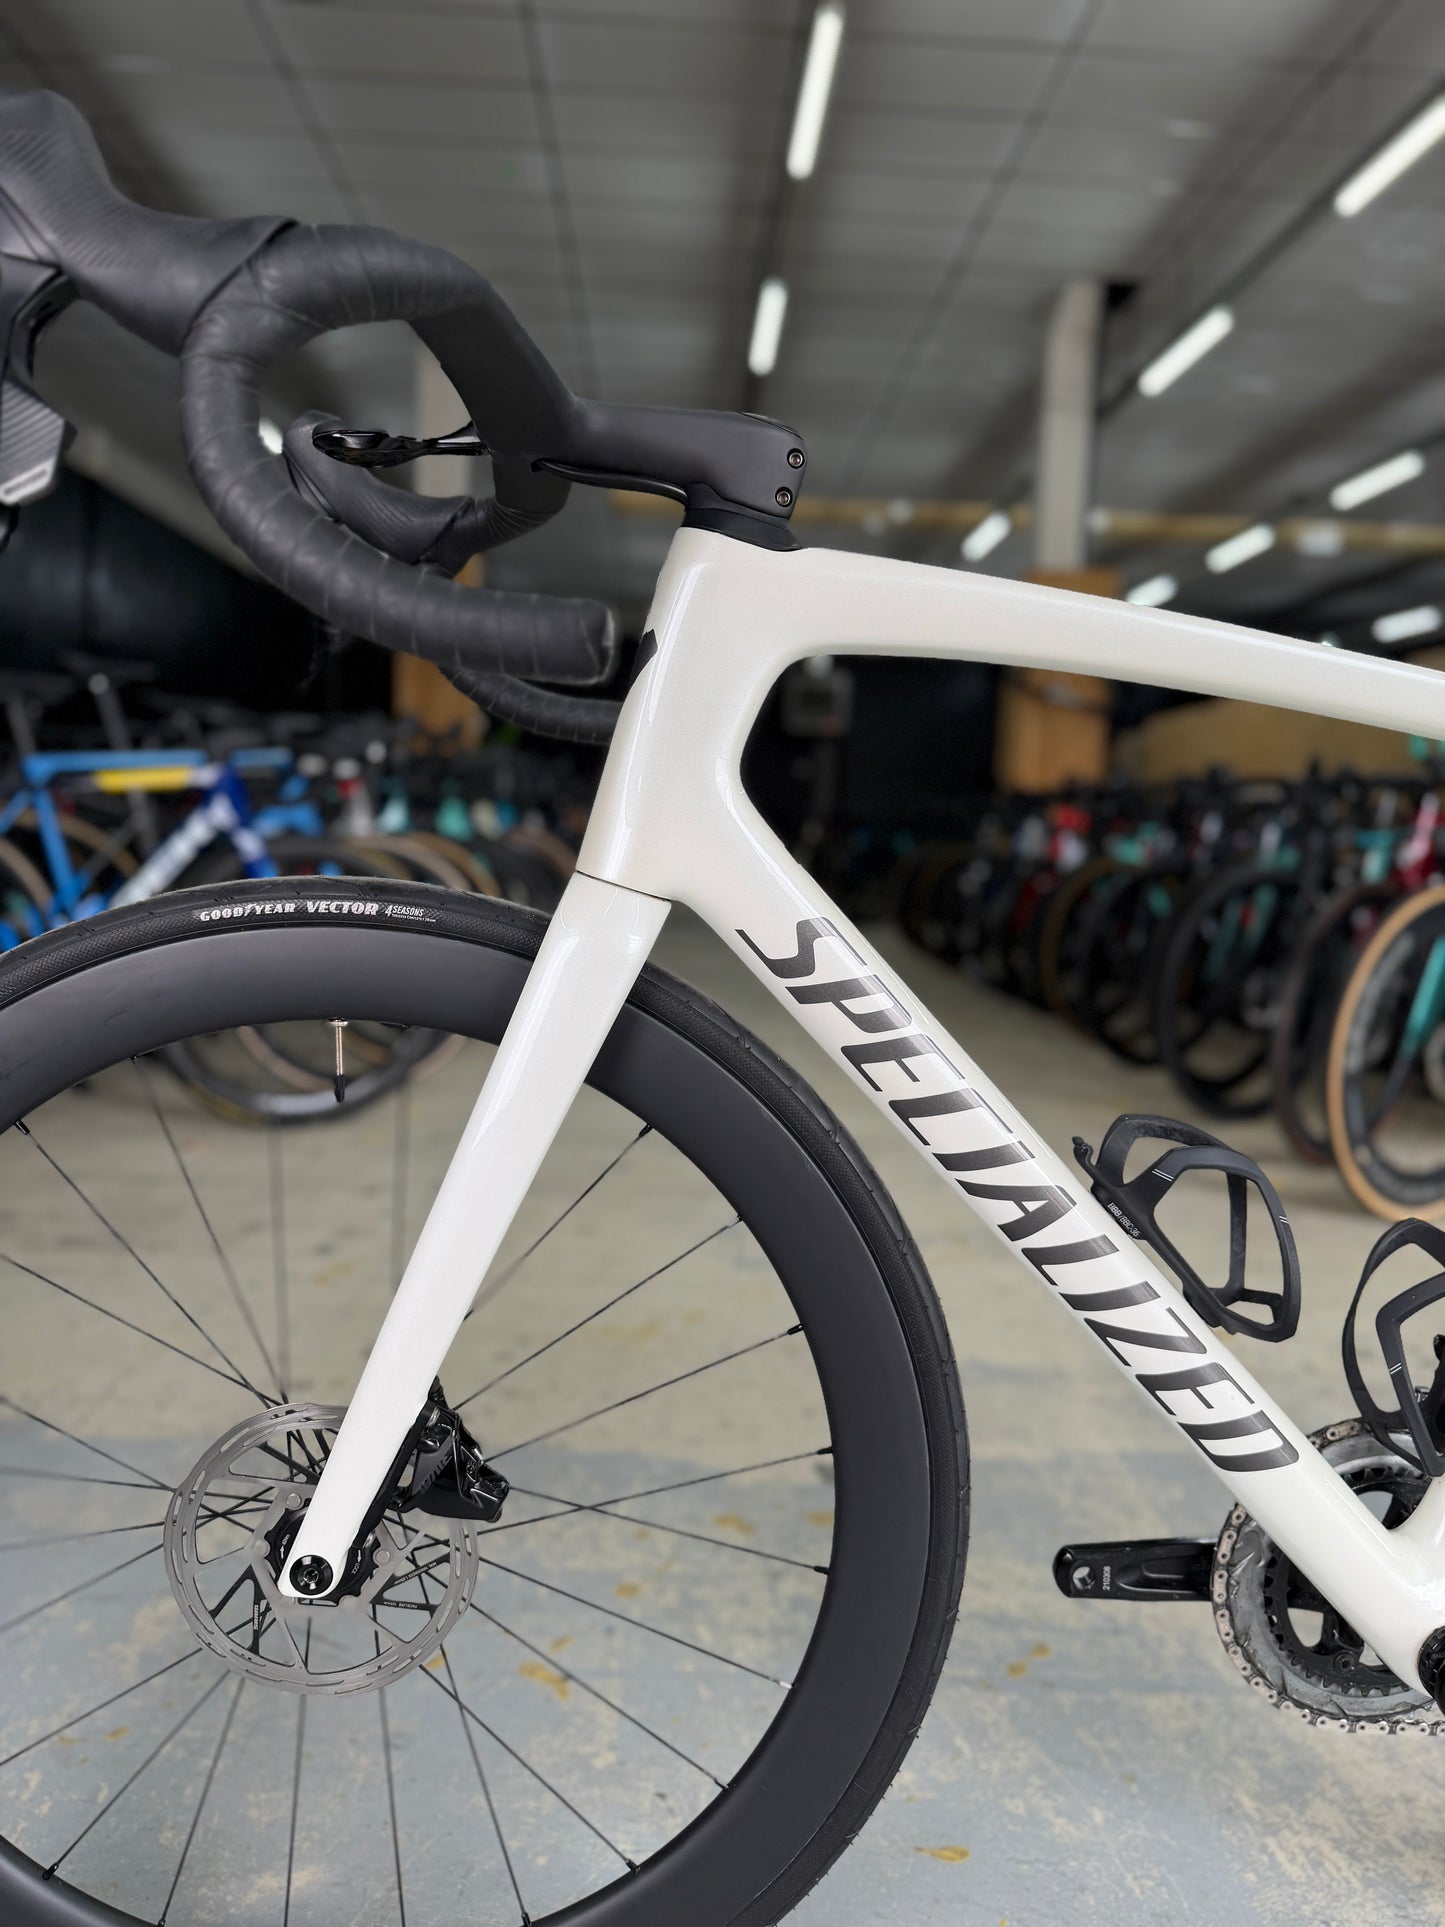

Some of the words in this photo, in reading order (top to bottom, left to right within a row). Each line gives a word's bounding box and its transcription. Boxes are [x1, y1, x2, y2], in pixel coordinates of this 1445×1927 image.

[200, 903, 296, 922] GOODYEAR
[307, 900, 379, 916] VECTOR
[735, 916, 1300, 1473] SPECIALIZED
